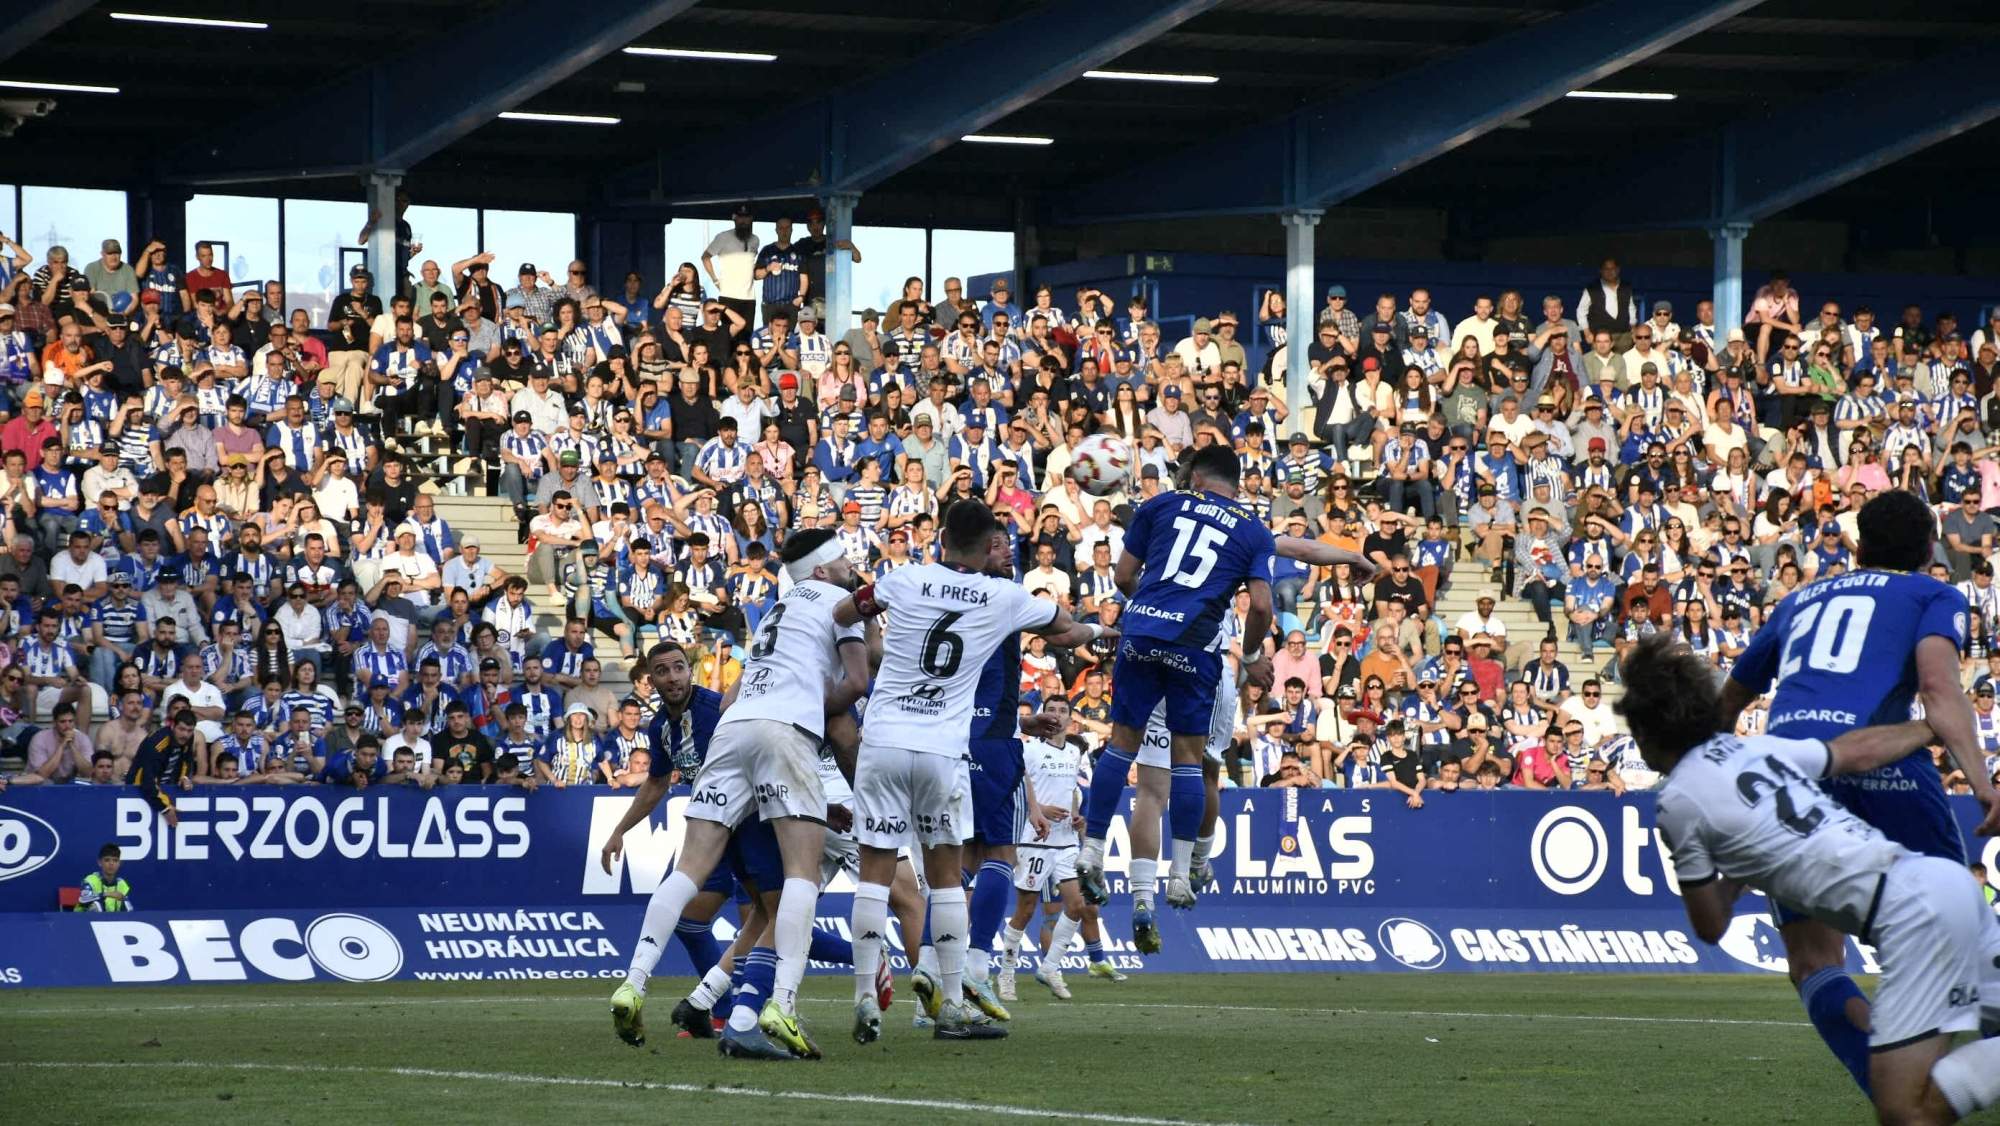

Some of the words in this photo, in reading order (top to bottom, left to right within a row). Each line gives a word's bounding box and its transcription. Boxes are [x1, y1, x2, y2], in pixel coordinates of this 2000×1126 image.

[1160, 516, 1229, 589] 15
[921, 583, 936, 598] K.
[941, 585, 989, 607] PRESA
[751, 603, 786, 662] 3
[919, 610, 964, 679] 6
[1776, 595, 1876, 683] 20
[116, 796, 530, 861] BIERZOGLASS
[1028, 857, 1044, 875] 10
[1233, 879, 1328, 894] ALUMINIO
[1338, 879, 1375, 894] PVC
[417, 909, 604, 932] NEUMÁTICA
[425, 935, 620, 960] HIDRÁULICA
[1196, 927, 1378, 962] MADERAS
[1450, 924, 1699, 963] CASTAÑEIRAS
[414, 967, 652, 981] www.nhbeco.co
